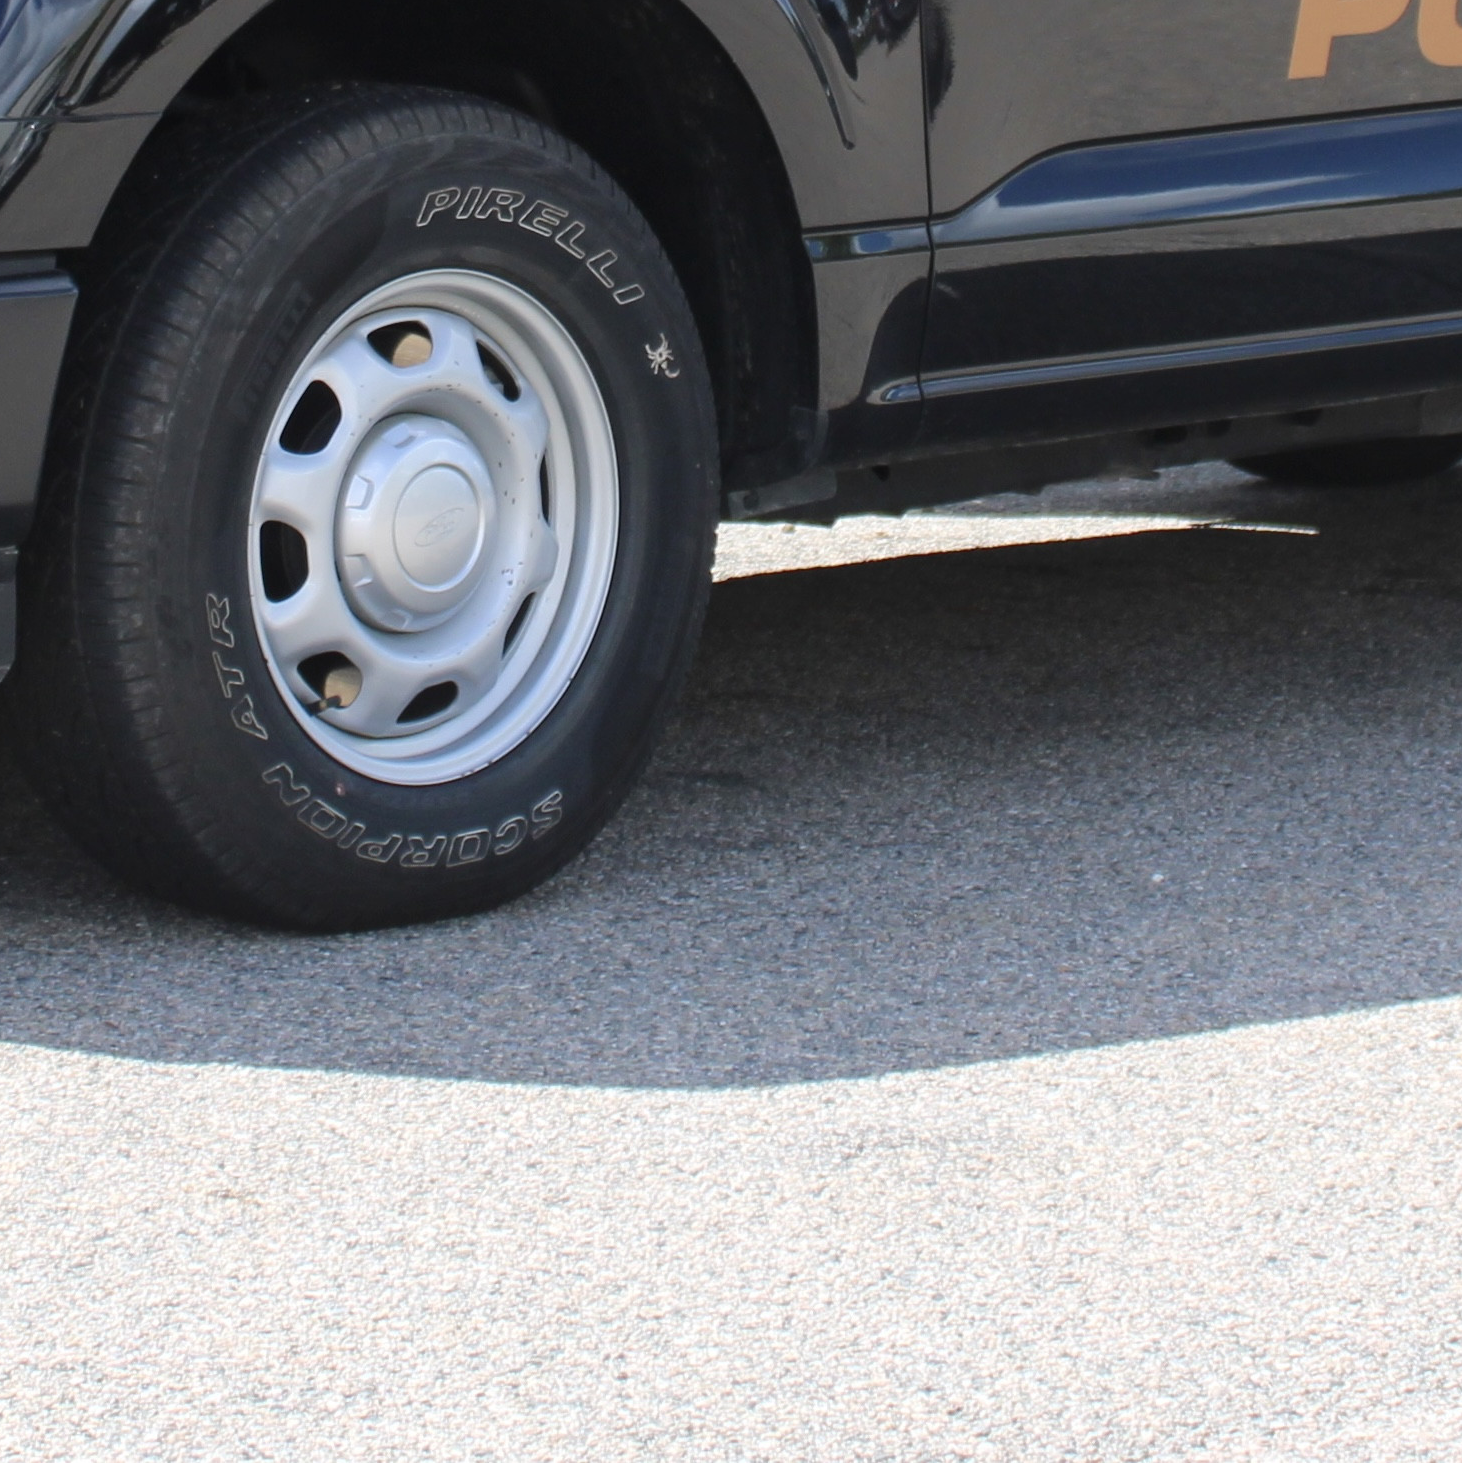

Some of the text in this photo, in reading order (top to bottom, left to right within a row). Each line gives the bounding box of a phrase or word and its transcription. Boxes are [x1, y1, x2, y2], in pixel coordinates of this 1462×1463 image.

[415, 185, 644, 305] PIRELLI
[205, 593, 564, 869] SCORPION ATR
